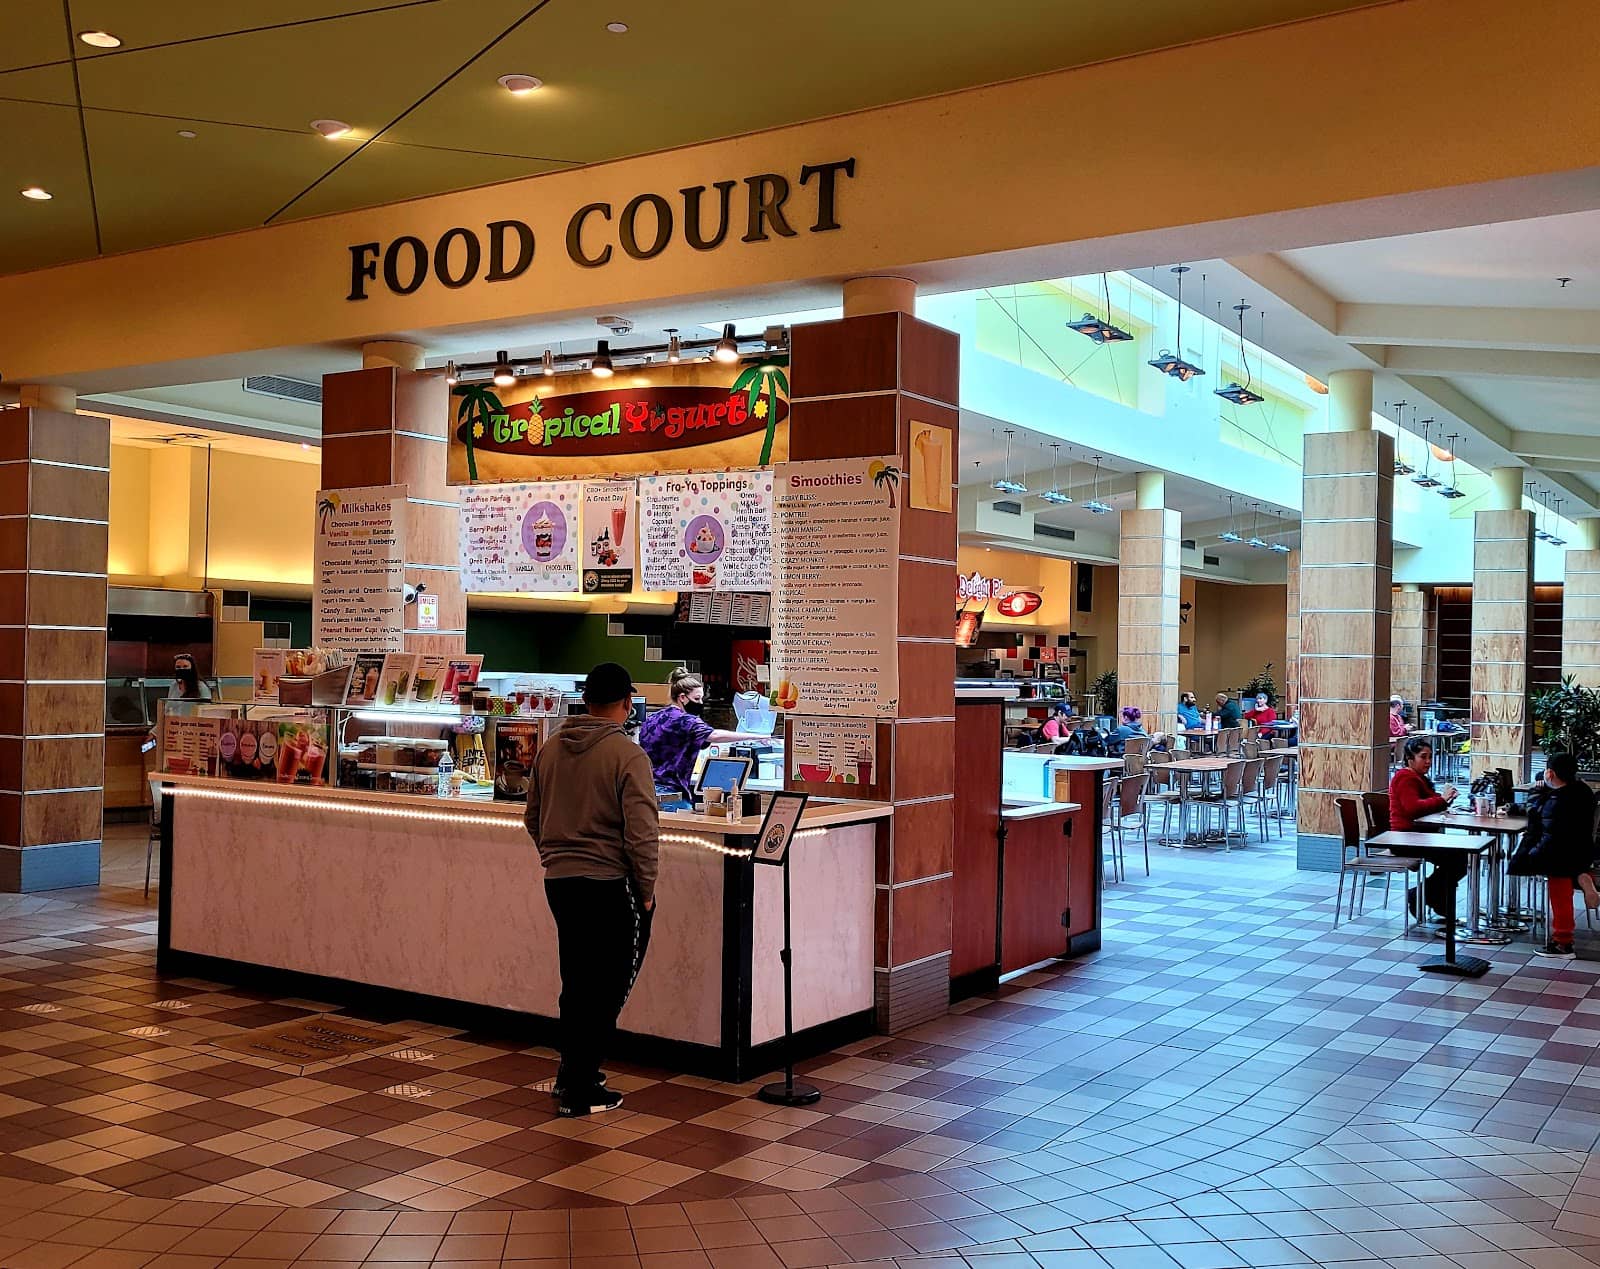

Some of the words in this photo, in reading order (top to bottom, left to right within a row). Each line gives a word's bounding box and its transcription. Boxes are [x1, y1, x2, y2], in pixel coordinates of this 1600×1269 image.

[346, 219, 536, 301] FOOD
[565, 157, 857, 269] COURT
[490, 400, 621, 447] Tropical
[666, 481, 697, 492] Fro-Yo
[701, 478, 748, 492] Toppings
[790, 473, 862, 488] Smoothies
[612, 494, 624, 502] Day
[341, 501, 391, 514] Milkshakes
[331, 520, 359, 528] Chocolate
[361, 519, 392, 528] Strawberry
[329, 530, 349, 538] Vanilla
[328, 540, 348, 548] Peanut
[352, 548, 373, 556] Nutella
